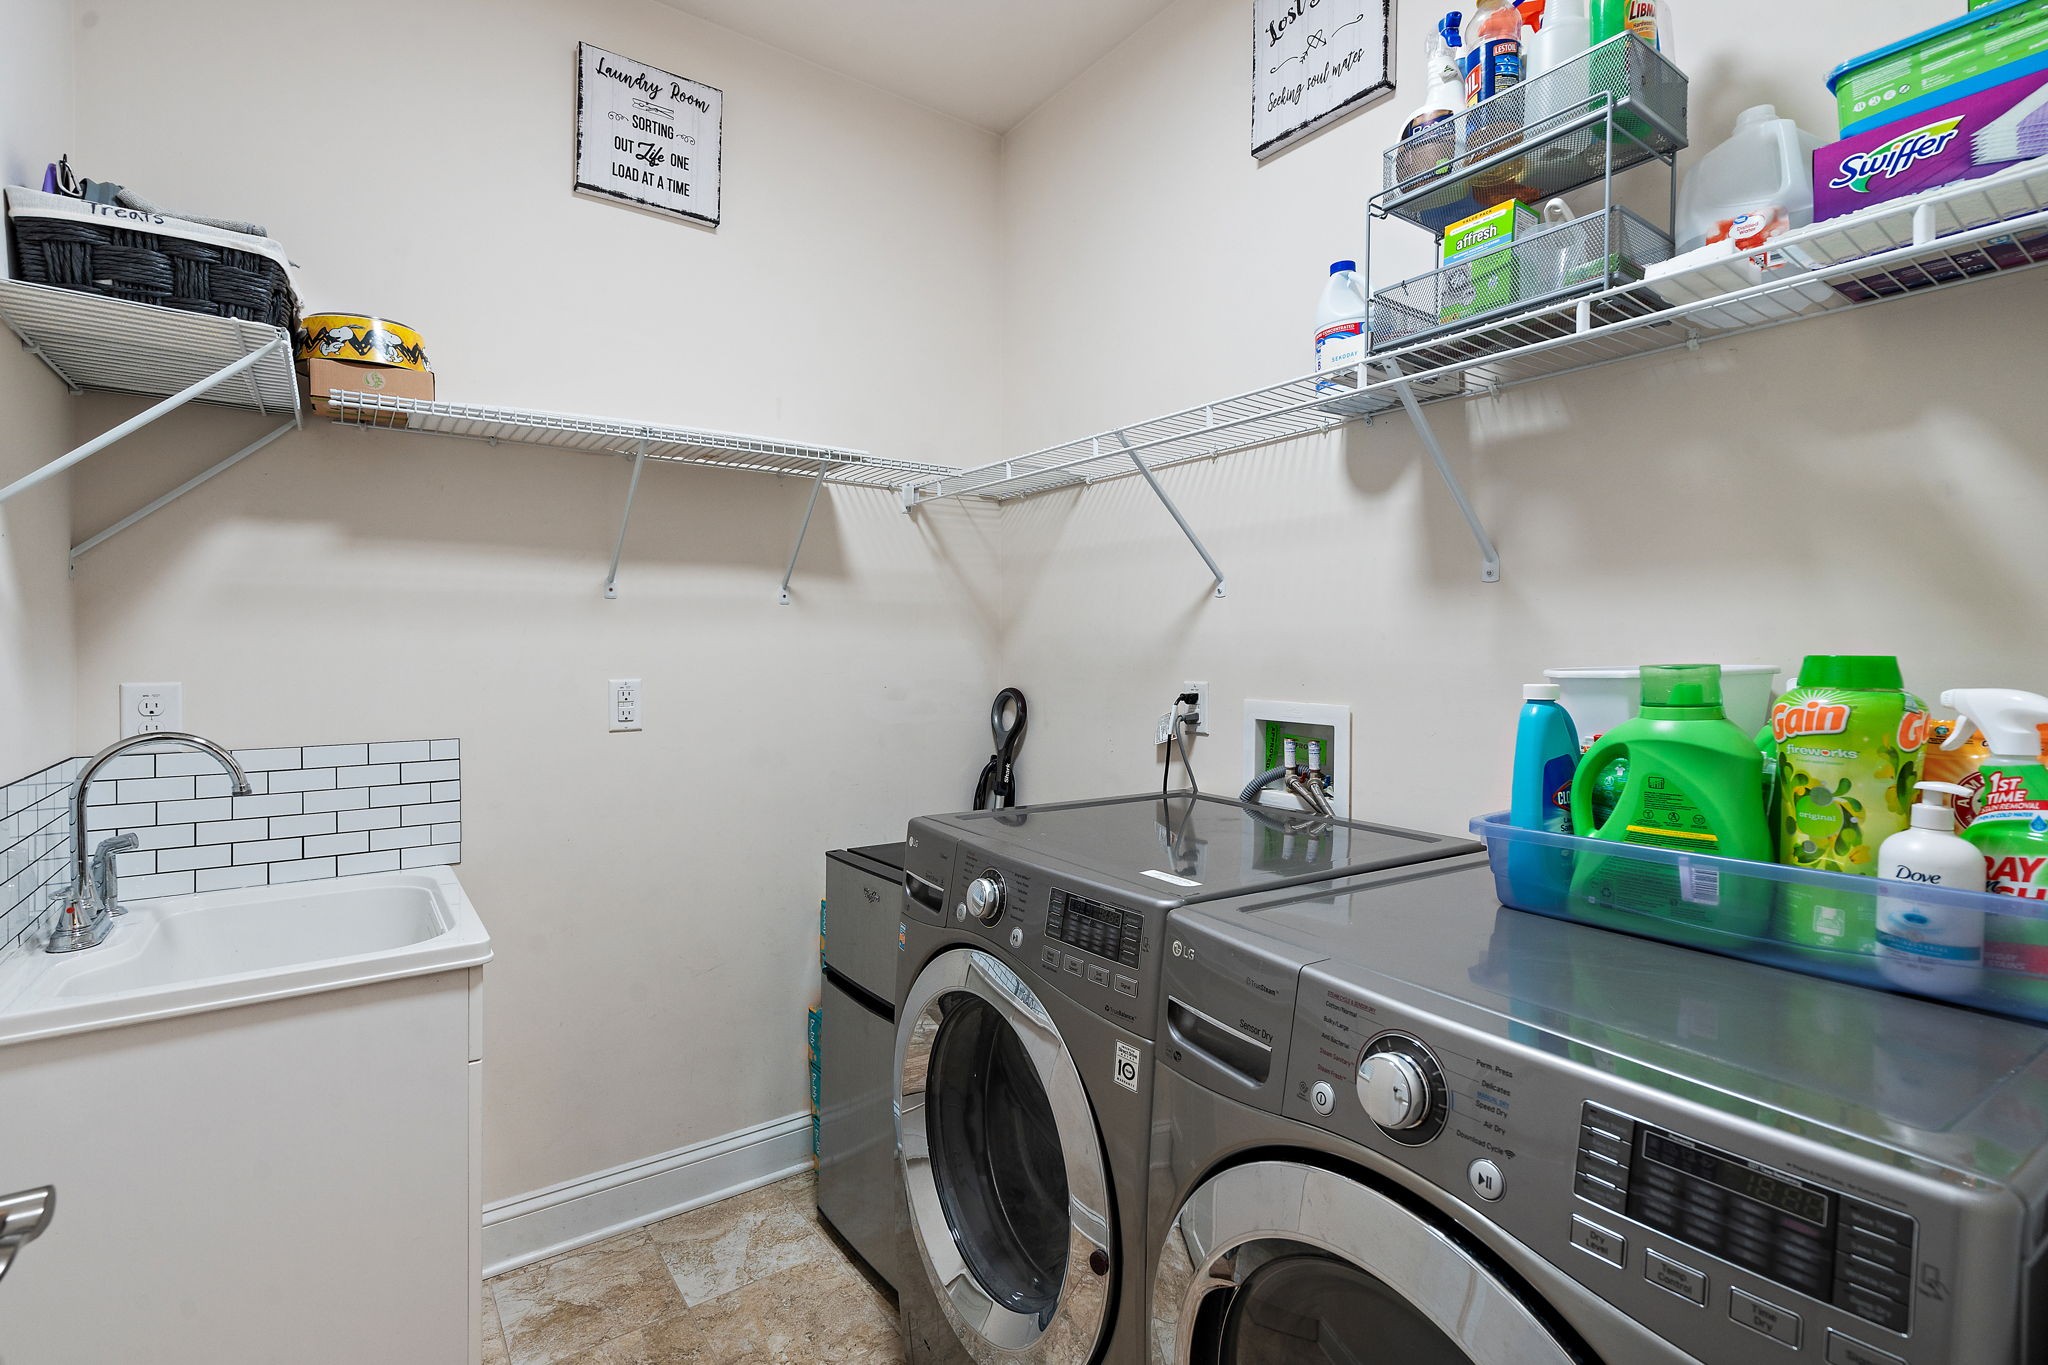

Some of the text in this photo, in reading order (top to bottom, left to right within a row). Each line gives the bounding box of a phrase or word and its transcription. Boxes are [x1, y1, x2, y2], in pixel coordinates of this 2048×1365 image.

[1265, 0, 1305, 47] Lost
[1494, 43, 1517, 54] LESTOIL
[595, 57, 710, 113] Laundry Room
[1267, 48, 1365, 112] Seeking soul mates
[632, 115, 674, 139] SORTING
[614, 136, 689, 171] OUT Life ONE
[1829, 130, 1957, 187] Swiffer
[612, 162, 690, 196] LOAD AT A TIME
[1456, 224, 1497, 250] affresh
[1773, 701, 1849, 741] Gain
[1266, 727, 1276, 768] APPROVED
[1787, 744, 1858, 759] fireworks
[1003, 763, 1011, 783] Shark
[1989, 771, 2022, 793] 1ST
[1986, 790, 2027, 805] TIME
[1999, 802, 2040, 810] REMOVAL
[1799, 811, 1836, 822] original
[1896, 865, 1941, 885] Dove
[1239, 1018, 1273, 1043] Sensor Dry
[1118, 1059, 1135, 1080] 10
[1495, 1066, 1513, 1078] Press
[1481, 1080, 1511, 1096] Delicates
[1476, 1099, 1508, 1118] Speed Dry
[1483, 1121, 1505, 1135] Air Dry
[1456, 1129, 1504, 1155] Download Cycle
[1585, 1239, 1609, 1256] Level
[1589, 1231, 1605, 1245] Dry
[1656, 1272, 1693, 1295] Control
[1752, 1303, 1778, 1323] Time
[1754, 1316, 1774, 1332] Dry
